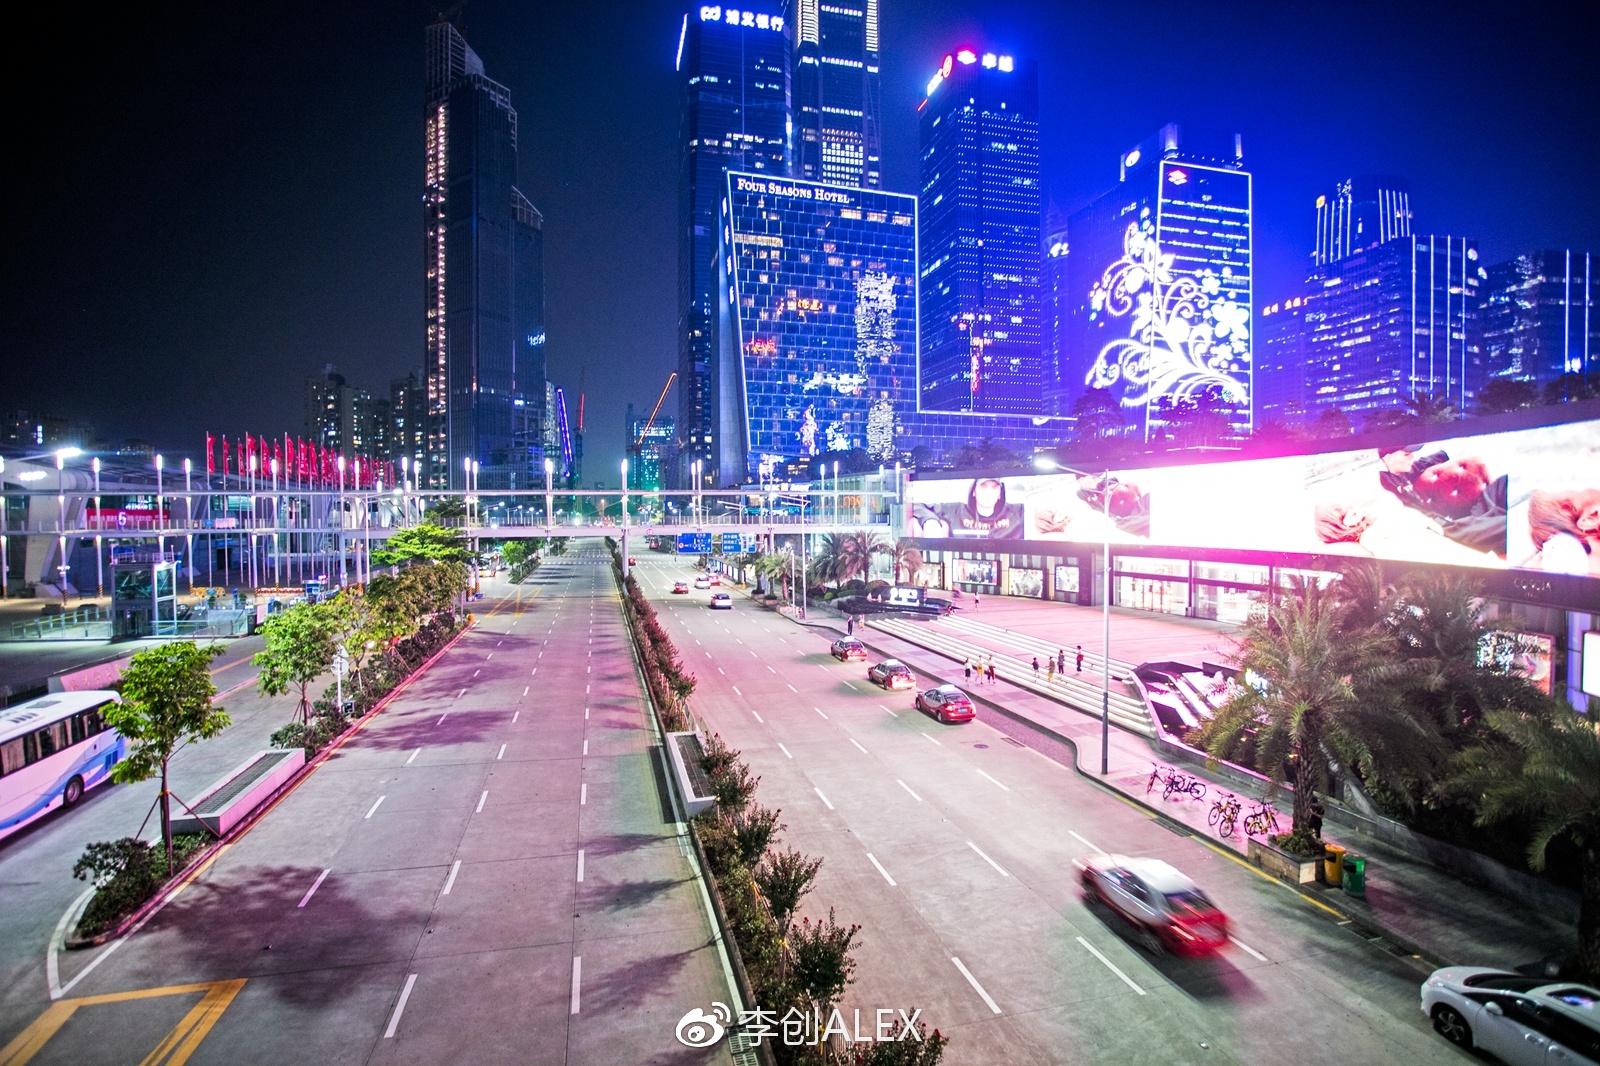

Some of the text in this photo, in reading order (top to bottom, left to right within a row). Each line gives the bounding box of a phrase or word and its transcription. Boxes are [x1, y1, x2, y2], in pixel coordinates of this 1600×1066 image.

[725, 9, 784, 32] 浦发银行
[737, 178, 850, 204] FOUR SEASONS HOTEL
[118, 511, 127, 526] 5
